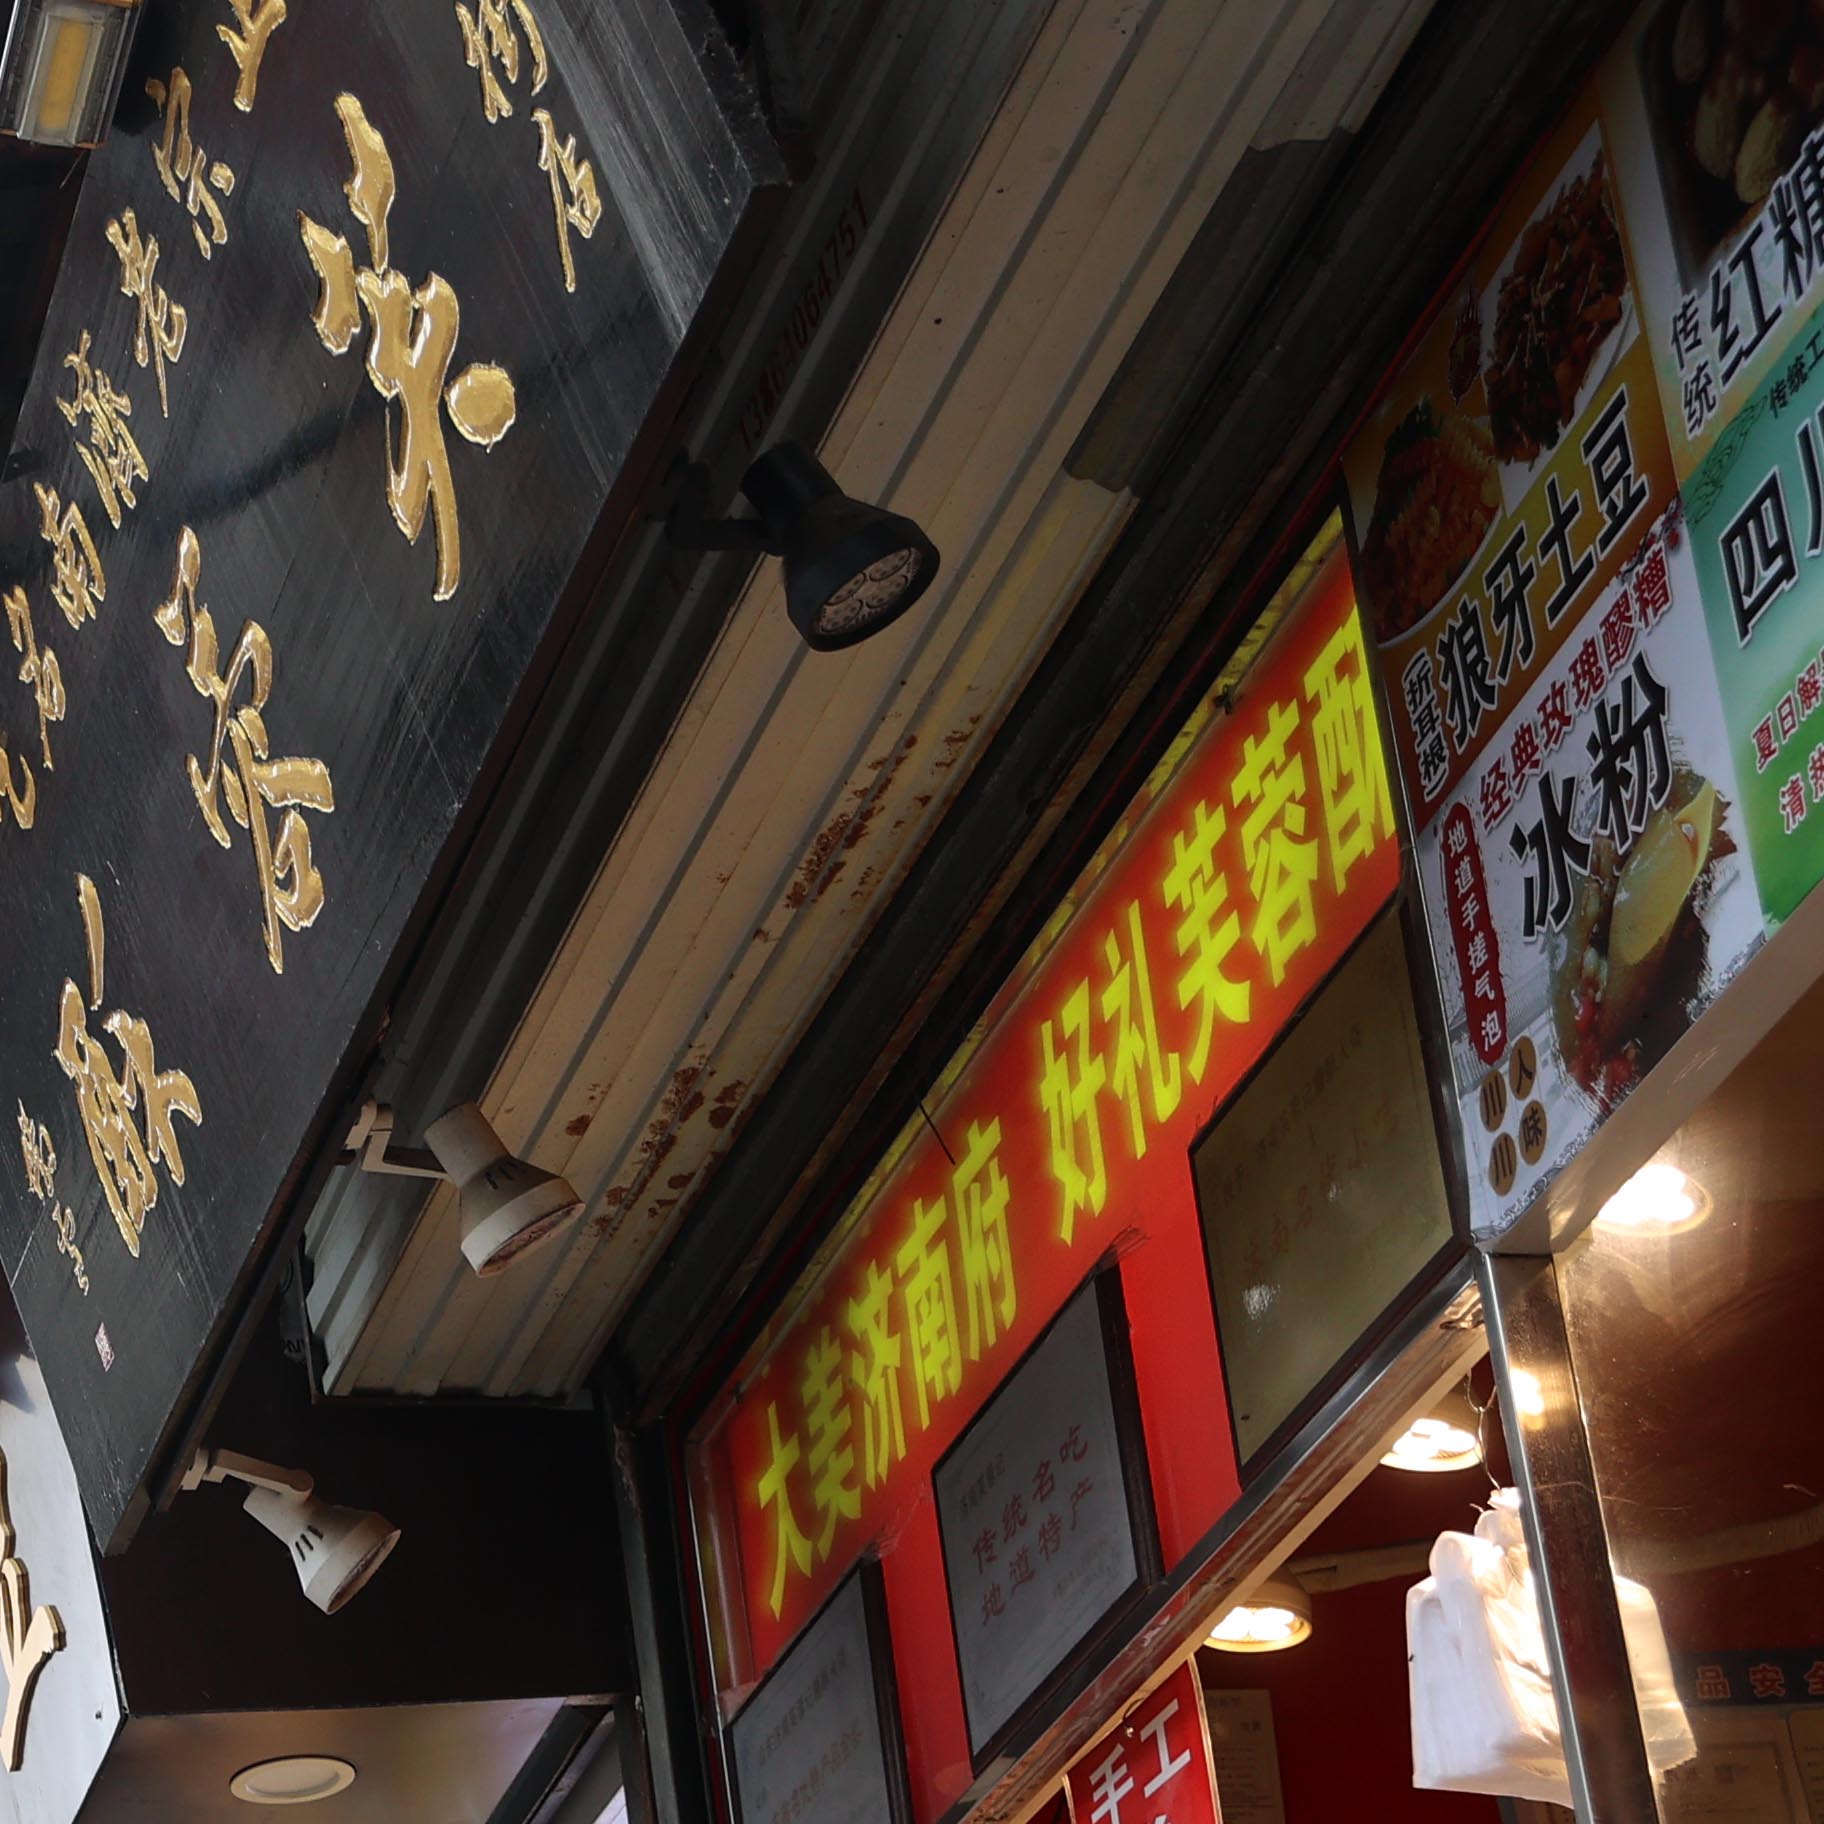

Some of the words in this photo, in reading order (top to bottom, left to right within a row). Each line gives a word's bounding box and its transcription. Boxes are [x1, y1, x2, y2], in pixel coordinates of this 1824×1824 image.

[1669, 294, 1716, 440] 传统
[54, 92, 516, 1258] 芙蓉酥
[1436, 388, 1648, 750] 狼牙土豆
[1478, 546, 1673, 834] 经典玫瑰醪糟
[1508, 650, 1672, 945] 冰粉
[1752, 646, 1824, 776] 夏日解
[1447, 826, 1504, 1054] 地道手搓气泡
[757, 1115, 1020, 1620] 大美济南府
[972, 1424, 1090, 1573] 传统名吃
[981, 1478, 1094, 1629] 地道特产
